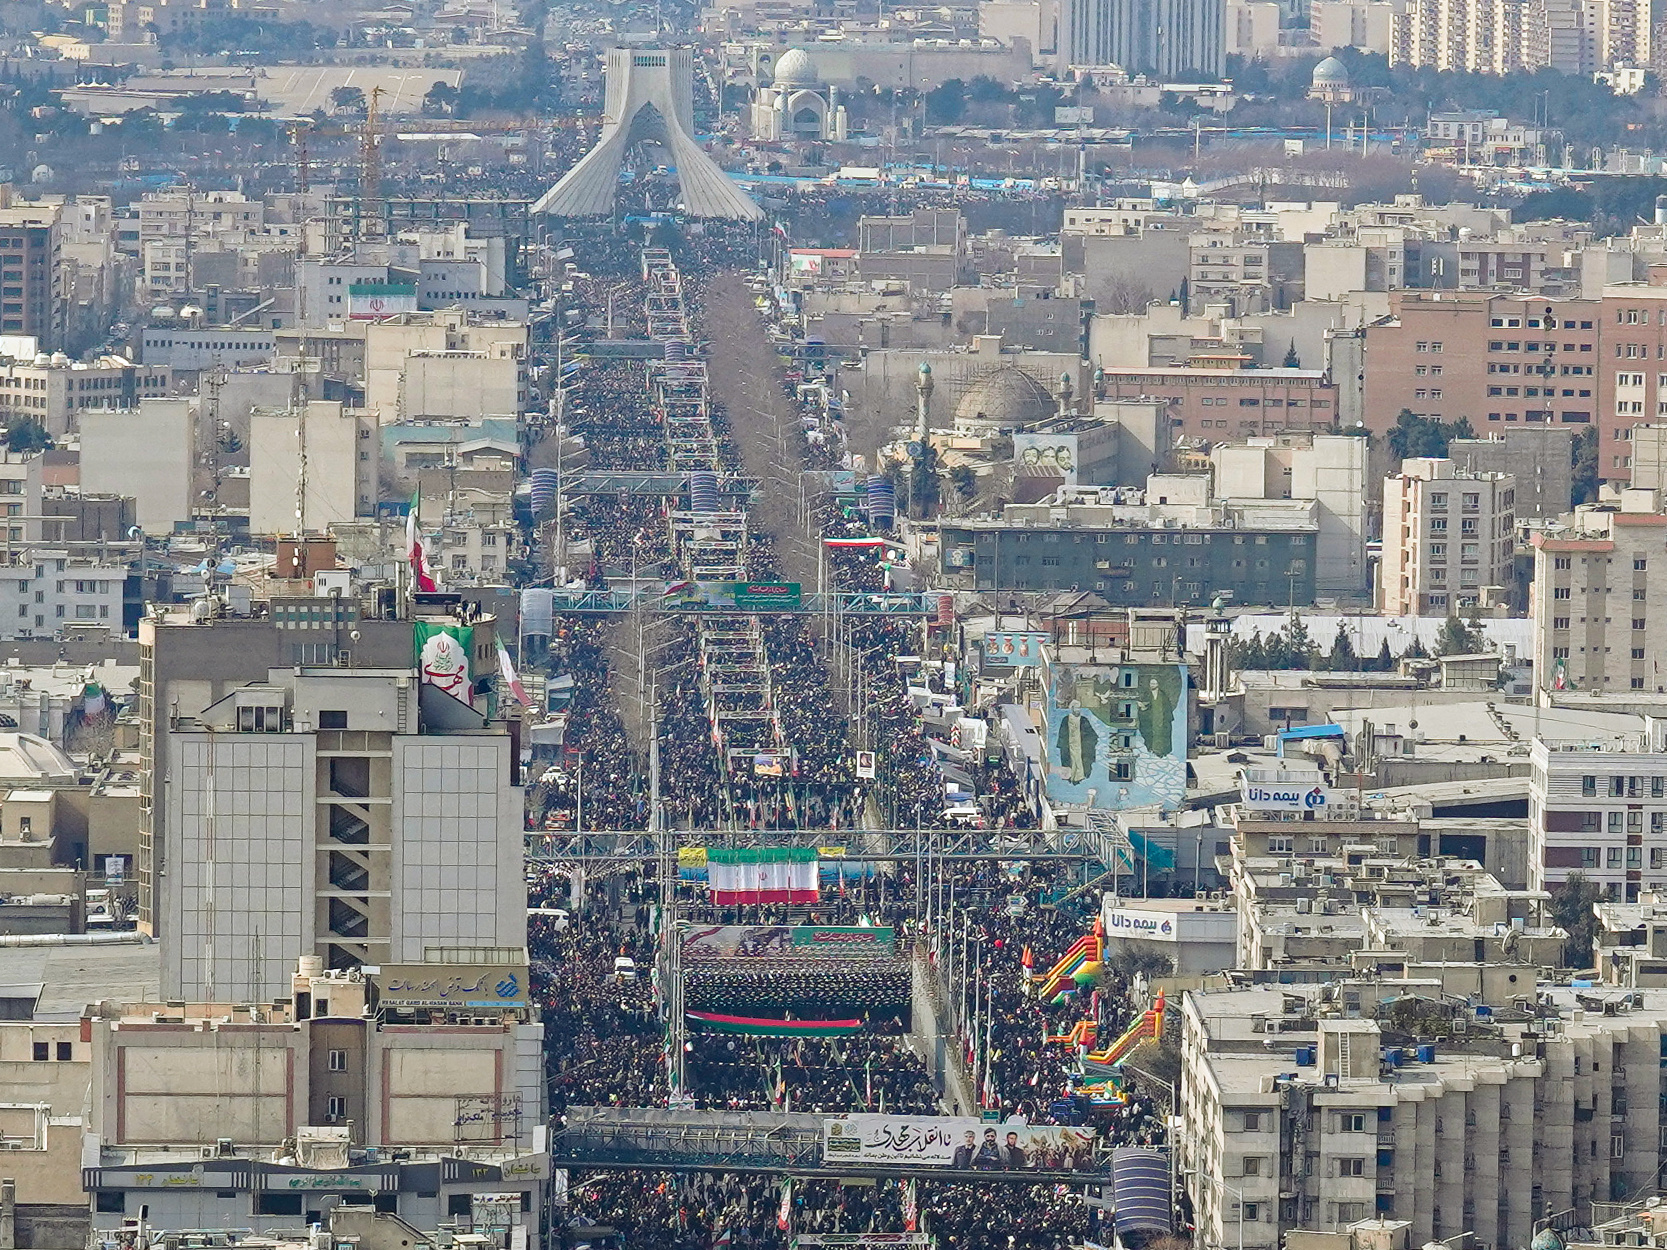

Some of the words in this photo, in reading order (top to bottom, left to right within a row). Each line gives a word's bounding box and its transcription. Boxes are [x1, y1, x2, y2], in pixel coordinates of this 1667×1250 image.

[1248, 788, 1271, 801] دانا
[1273, 792, 1299, 806] بیمه
[1111, 913, 1132, 928] دانا
[1133, 918, 1157, 934] بیمه
[388, 978, 421, 992] رسالت
[439, 976, 462, 998] قرض
[462, 972, 491, 997] بانک
[892, 1126, 942, 1152] انقلاب
[504, 1162, 541, 1178] ساختمان
